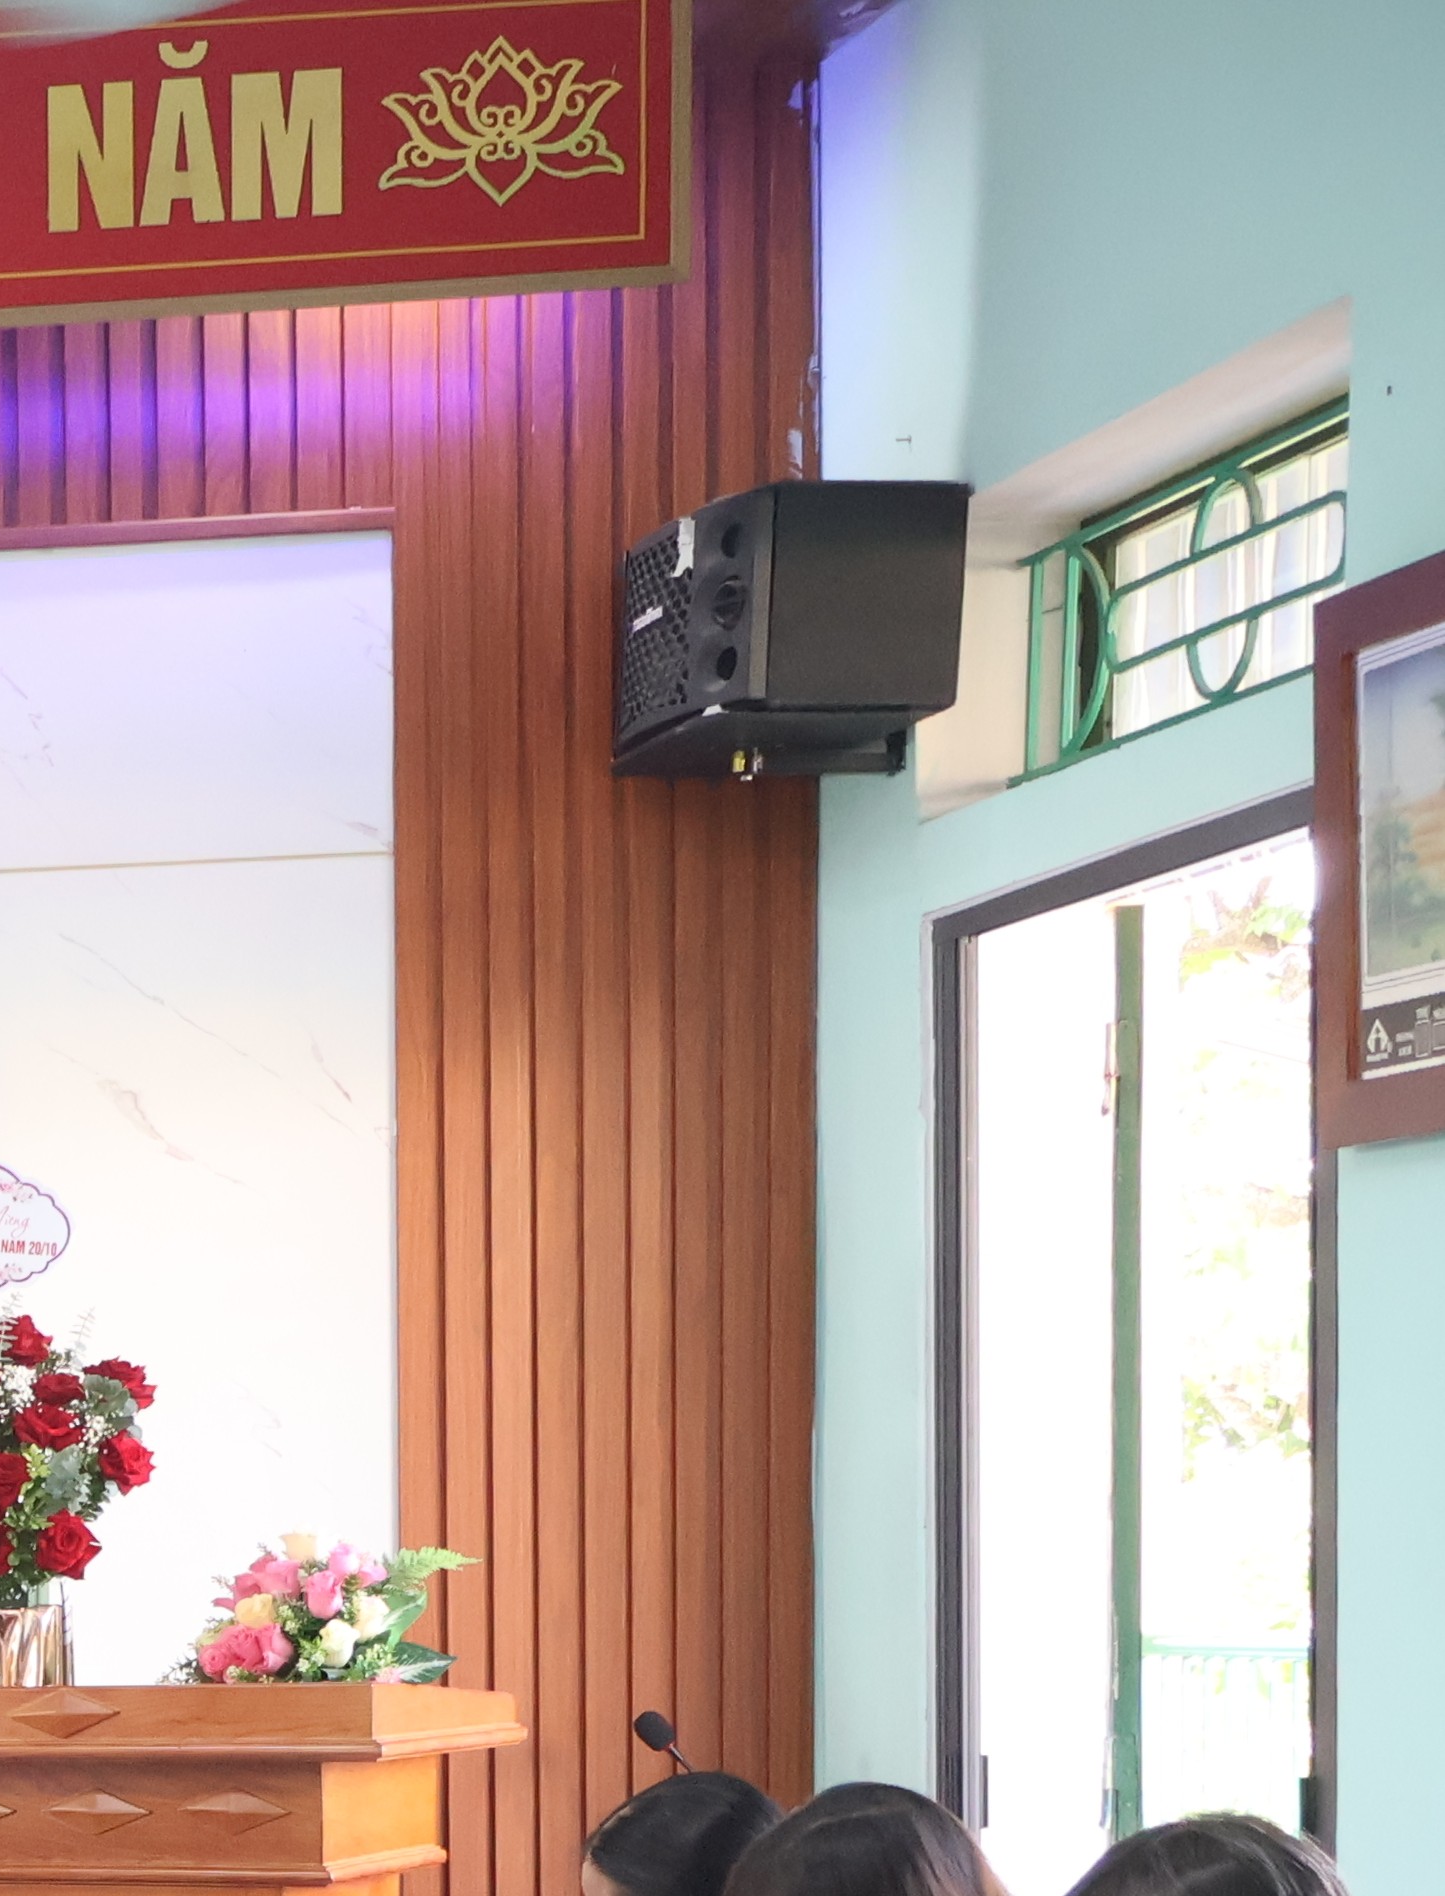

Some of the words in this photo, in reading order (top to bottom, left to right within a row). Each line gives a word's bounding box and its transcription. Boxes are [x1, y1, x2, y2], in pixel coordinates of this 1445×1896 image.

[47, 41, 344, 233] NĂM
[1, 1240, 25, 1254] NAM
[29, 1241, 57, 1257] 20/10
